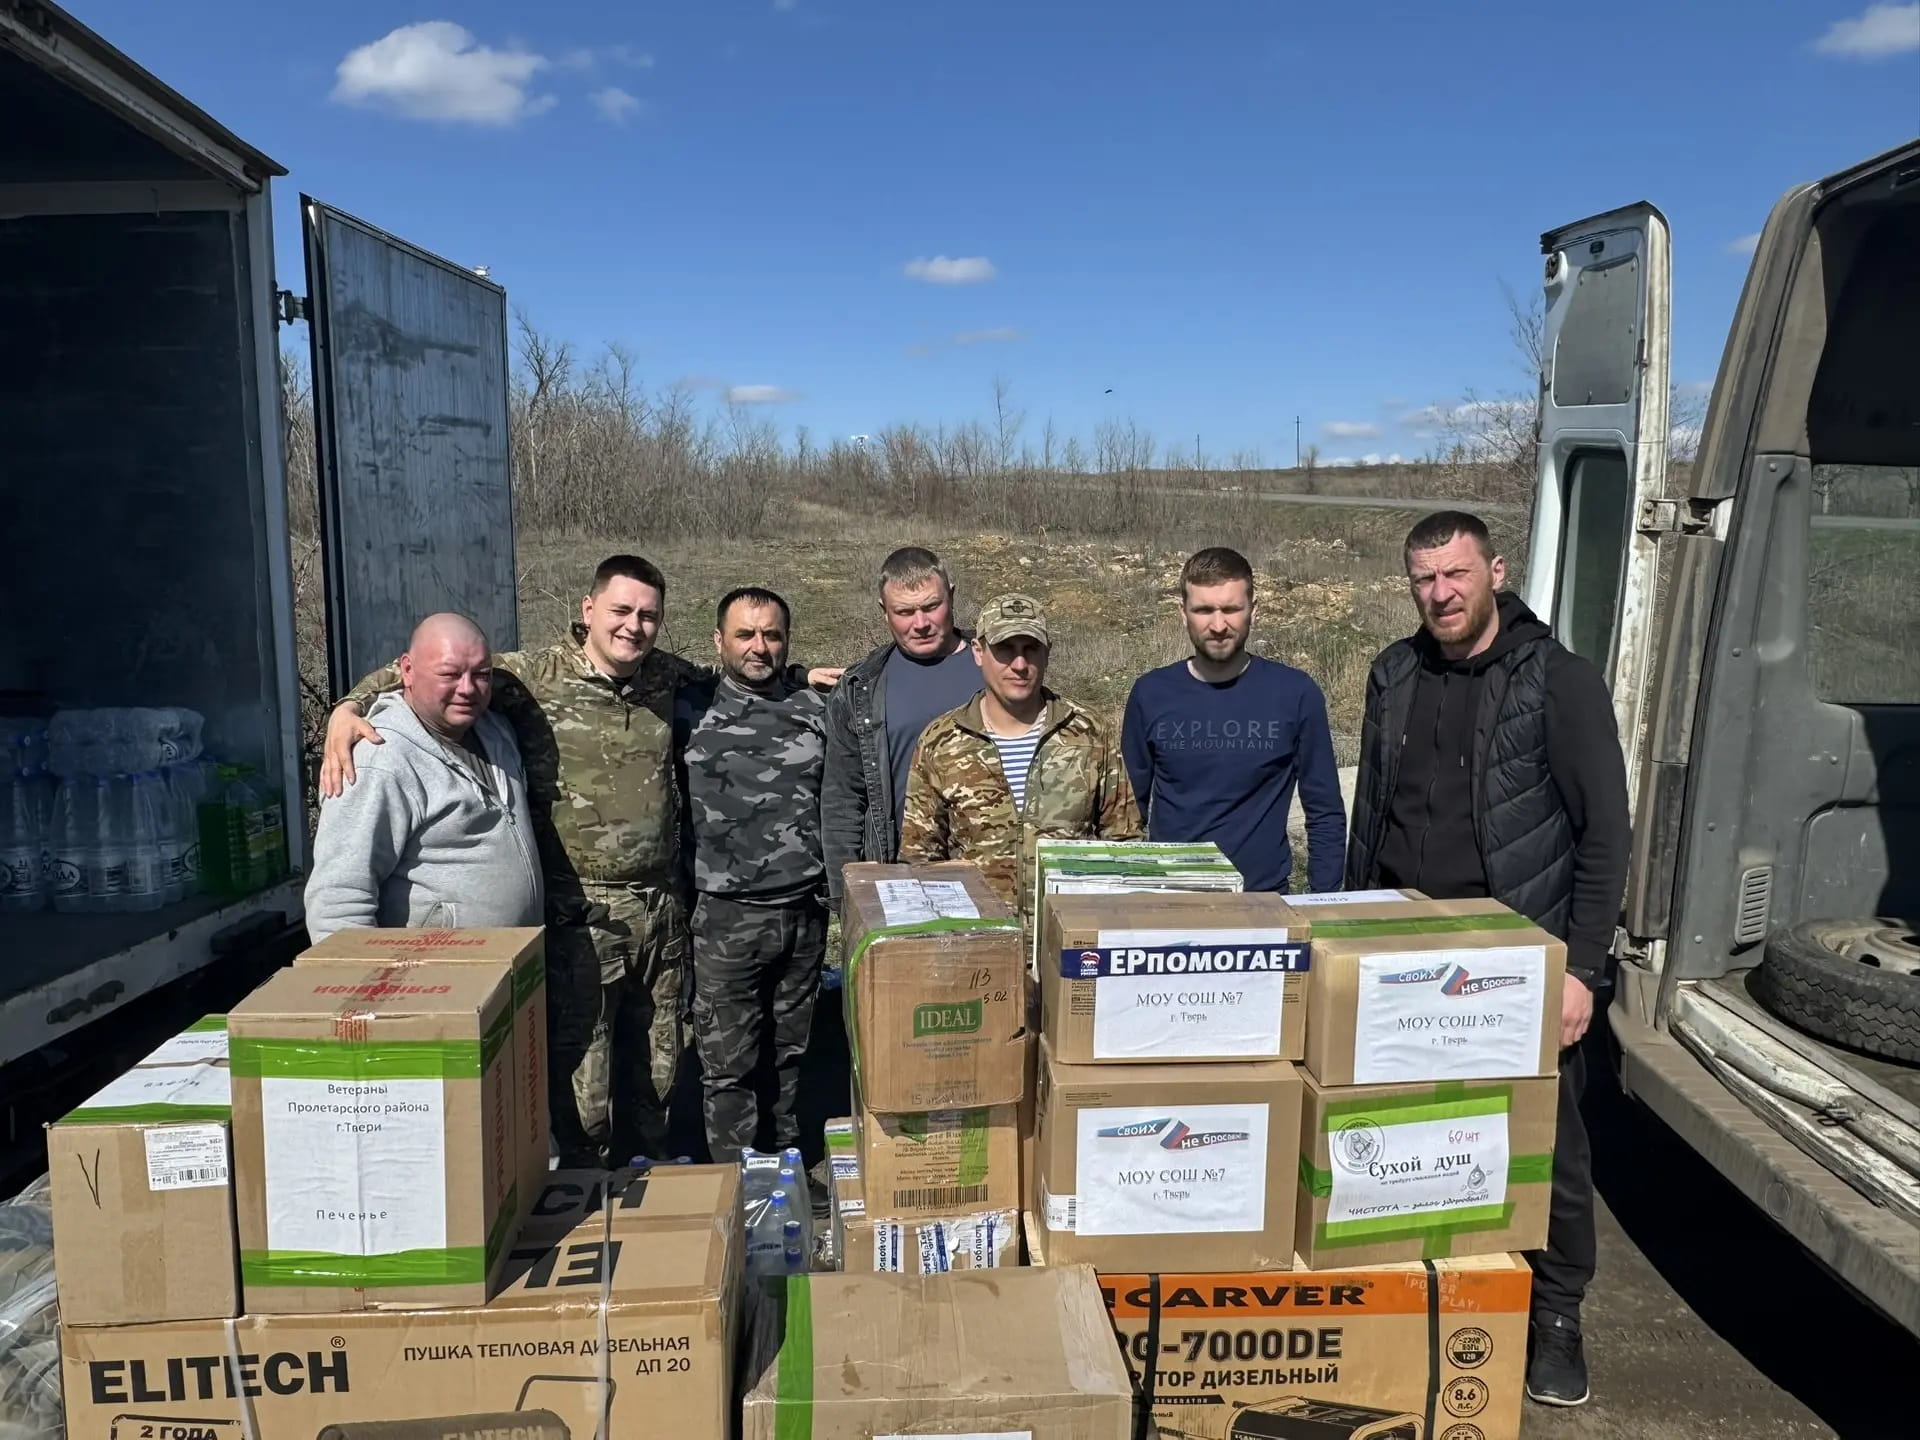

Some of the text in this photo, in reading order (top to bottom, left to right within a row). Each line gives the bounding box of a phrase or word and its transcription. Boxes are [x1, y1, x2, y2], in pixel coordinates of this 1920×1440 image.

[1156, 719, 1281, 739] EXPLORE
[1162, 739, 1275, 750] THE MOUNTAIN
[1136, 991, 1243, 1007] МОУ СОШ №7
[919, 1007, 976, 1030] IDEAL
[1181, 1011, 1208, 1023] Тверь
[1397, 1014, 1504, 1031] МОУ СОШ №7
[1441, 1035, 1468, 1047] Тверь
[328, 1084, 388, 1097] Ветераны
[288, 1100, 429, 1115] Пролетарского района
[1368, 1153, 1472, 1180] Сухой душ
[1118, 1168, 1226, 1185] МОУ СОШ №7
[1163, 1189, 1191, 1201] Тверь
[316, 1209, 388, 1221] Печенье
[1348, 1203, 1400, 1216] ЧИСТОТА
[1410, 1277, 1457, 1295] POER
[1124, 1286, 1366, 1308] CARVER
[403, 1345, 473, 1361] ПУШКА
[477, 1341, 575, 1359] ТЕПЛОВАЯ
[635, 1358, 691, 1375] ДП 20
[88, 1350, 350, 1405] ELITECH
[1200, 1363, 1339, 1389] ДИЗЕЛЬНЫЙ
[1454, 1388, 1476, 1401] 8.6
[140, 1425, 154, 1439] 2
